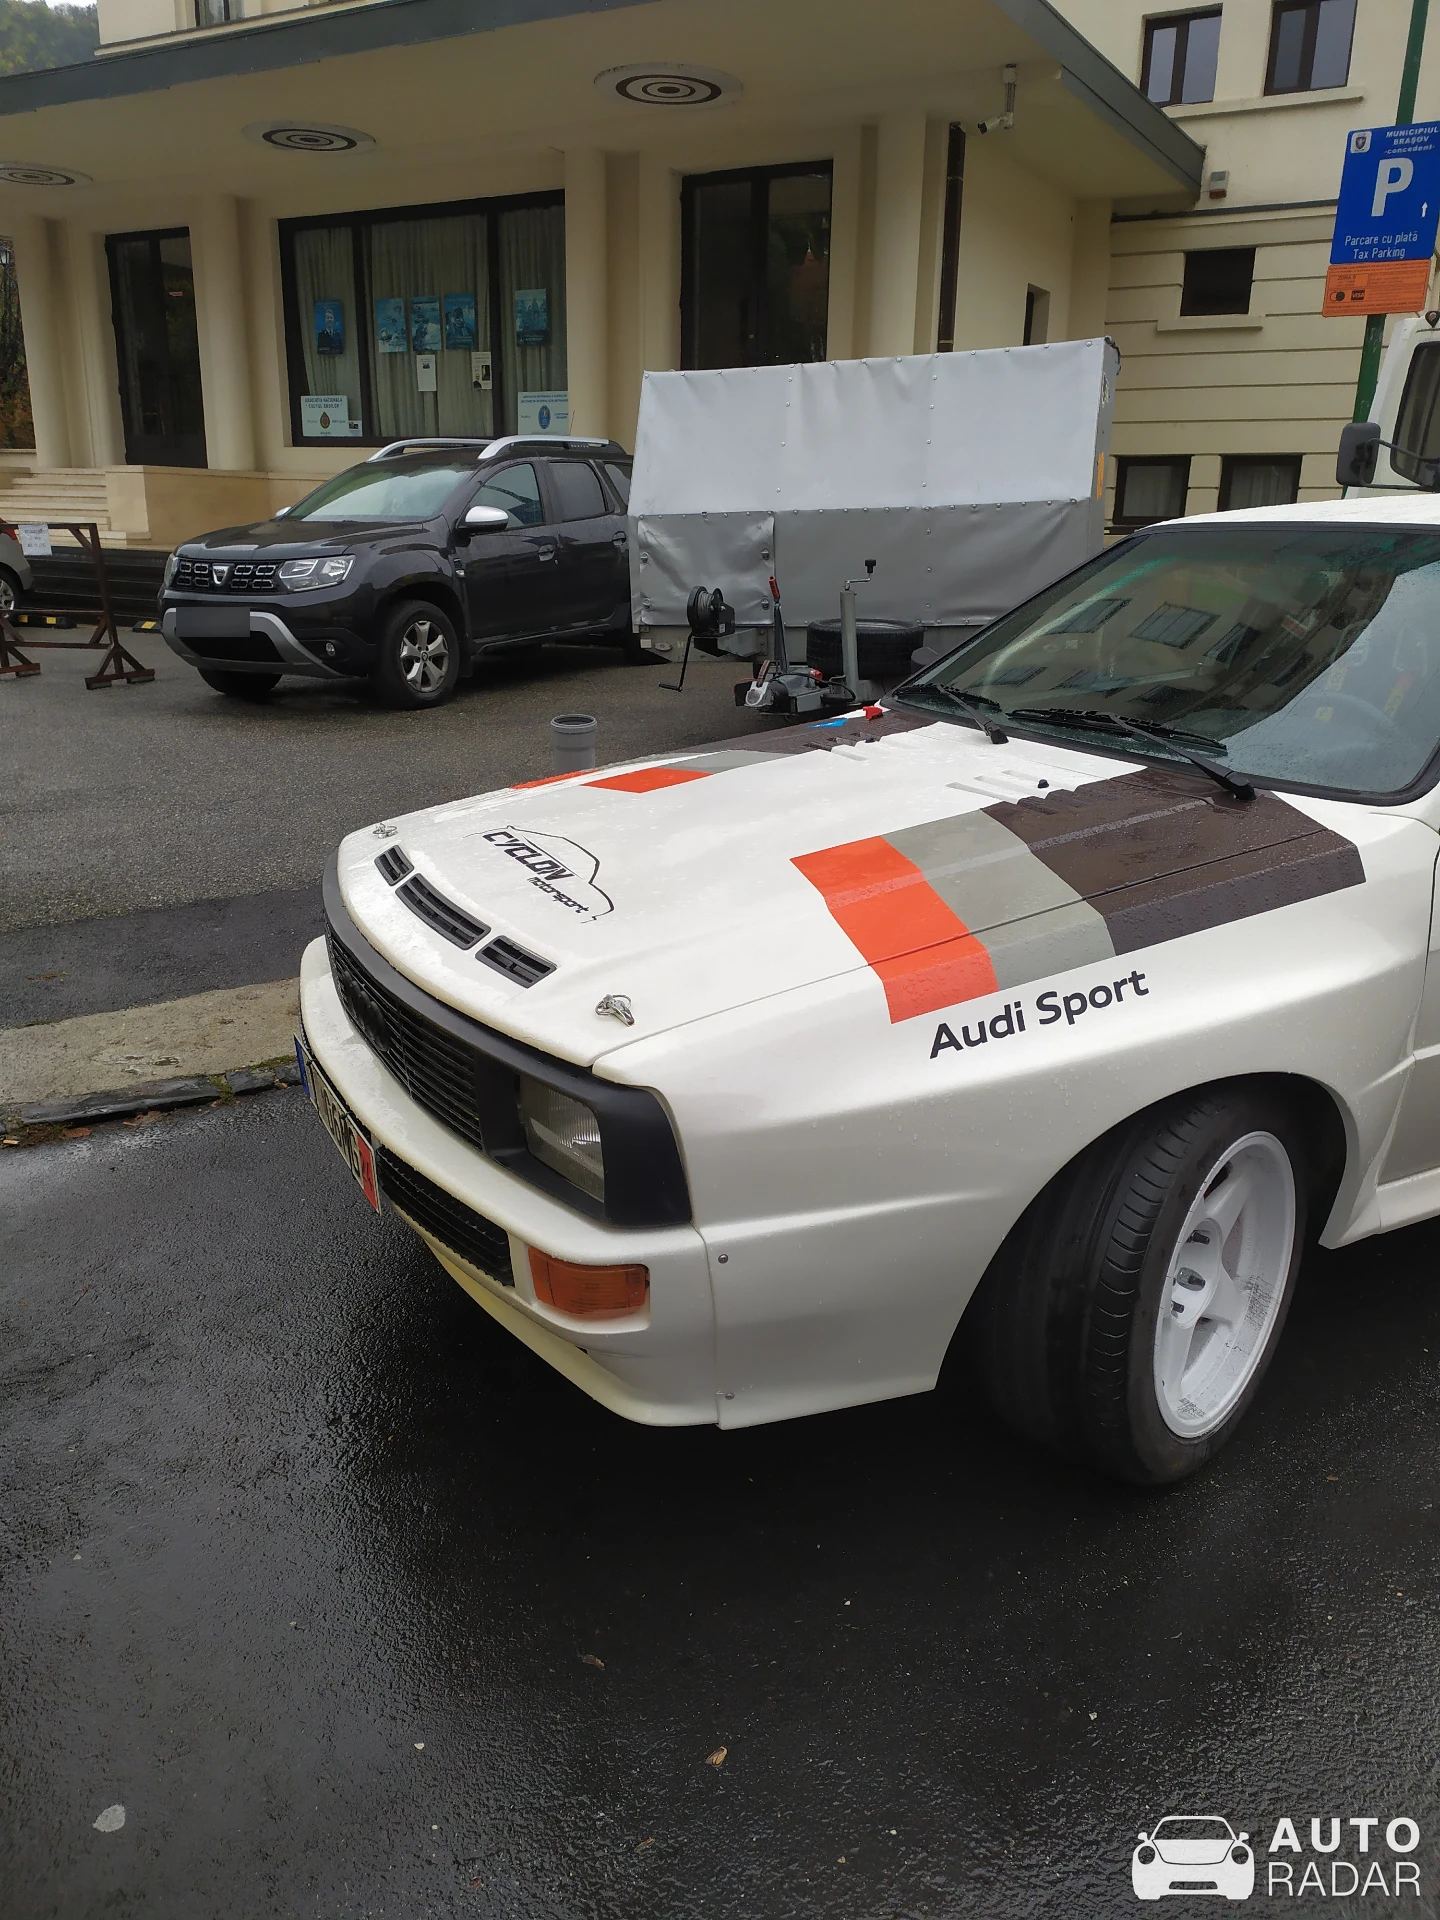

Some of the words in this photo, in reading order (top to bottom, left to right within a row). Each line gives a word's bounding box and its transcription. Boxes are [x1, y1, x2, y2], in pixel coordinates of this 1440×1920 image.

[1386, 126, 1439, 138] MUNICIPIUL
[1371, 157, 1414, 217] P
[1344, 235, 1379, 246] Parcare
[1381, 235, 1393, 244] cu
[1353, 248, 1369, 260] Tax
[1371, 246, 1406, 259] Parking
[929, 1000, 1027, 1060] Audi
[1036, 970, 1150, 1026] Sport
